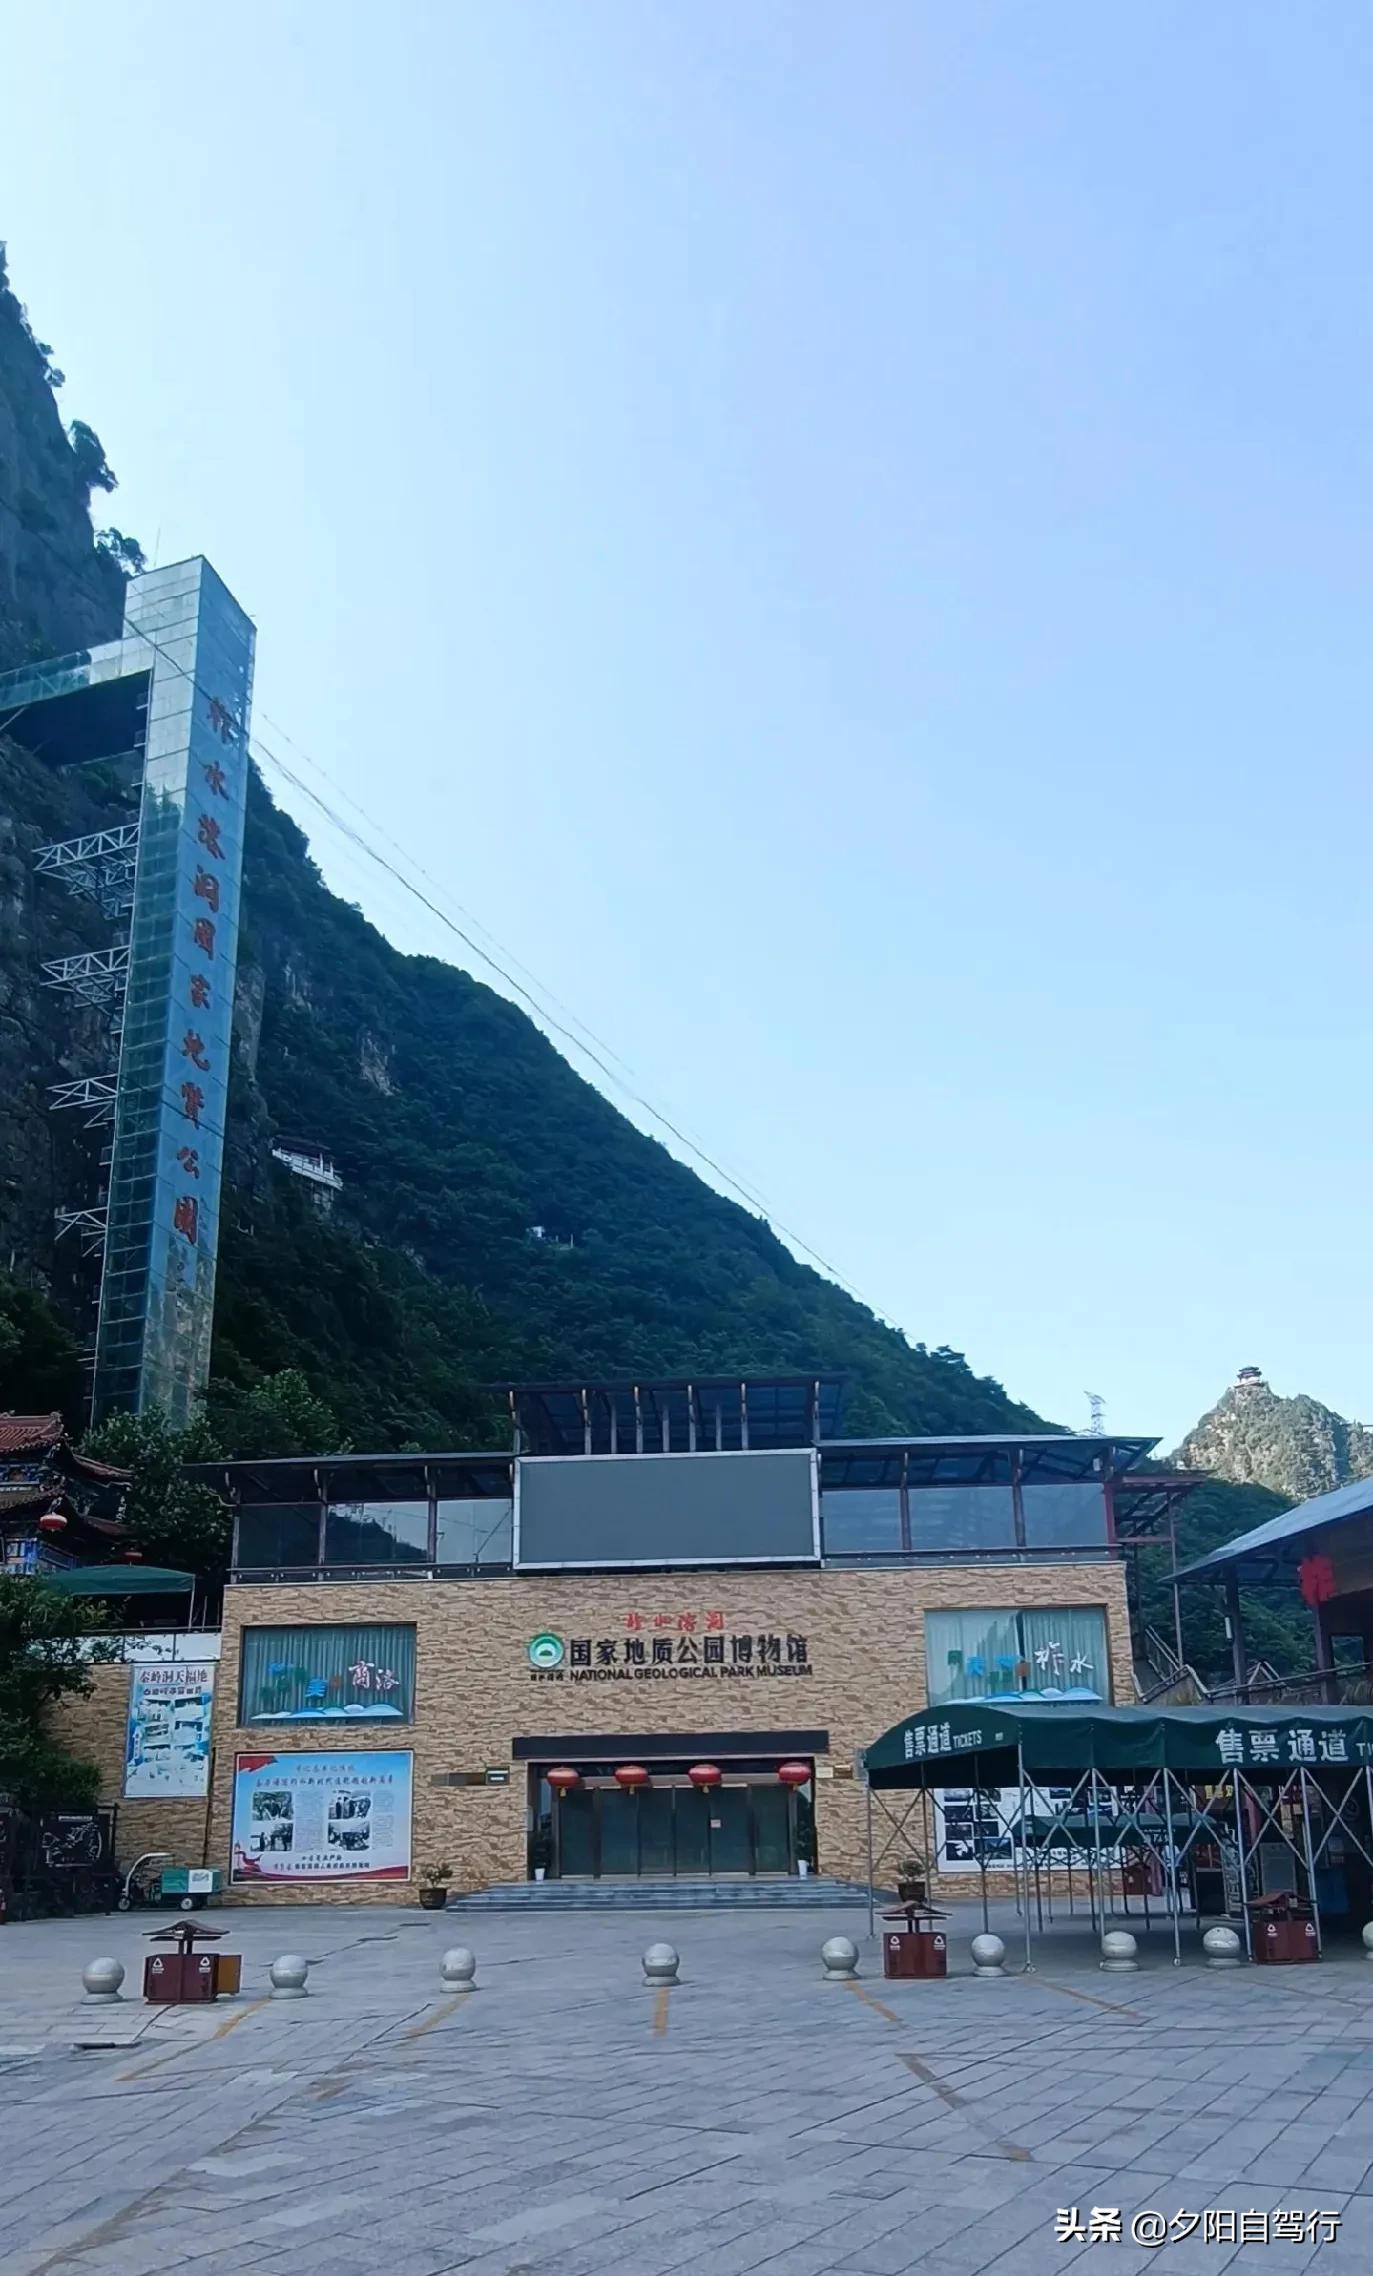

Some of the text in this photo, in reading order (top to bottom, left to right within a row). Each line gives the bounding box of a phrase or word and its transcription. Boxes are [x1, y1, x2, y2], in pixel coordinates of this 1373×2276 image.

[570, 1634, 808, 1666] 国家地质公园博物馆
[1034, 1641, 1094, 1675] 柞水
[140, 1669, 208, 1684] 秦岭洞天福地
[349, 1660, 400, 1690] 商洛
[570, 1669, 634, 1681] NATIONAL
[635, 1667, 718, 1680] GEOLOGICAL
[720, 1666, 754, 1678] PARK
[756, 1664, 813, 1677] MUSEUM
[904, 1722, 982, 1759] 售票通道 TICKETS
[1215, 1727, 1349, 1764] 售票通道
